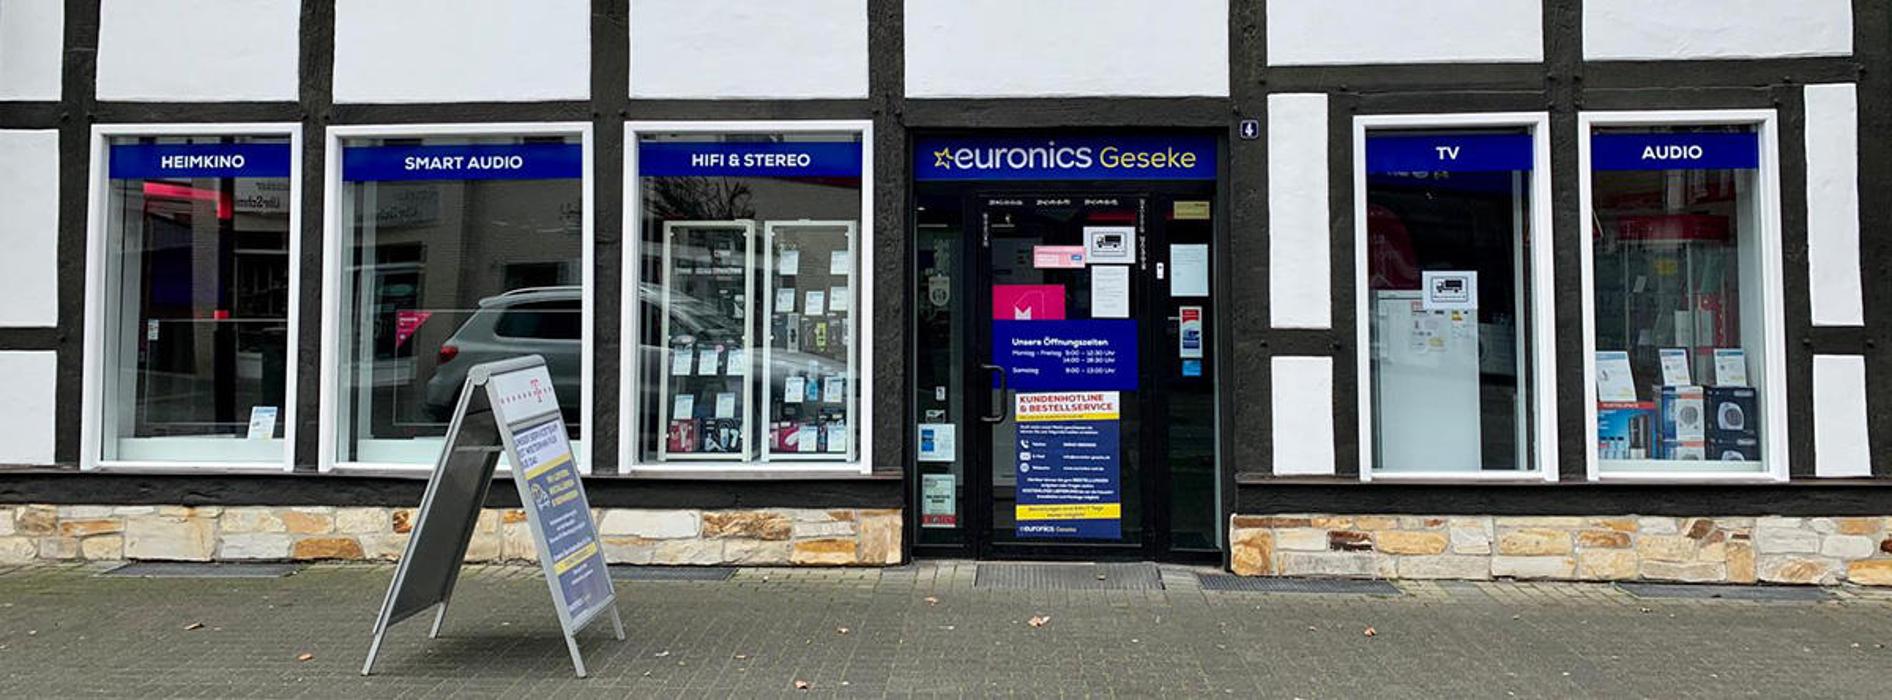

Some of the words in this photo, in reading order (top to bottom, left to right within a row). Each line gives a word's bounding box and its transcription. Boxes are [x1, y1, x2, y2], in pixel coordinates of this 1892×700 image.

[1244, 122, 1254, 137] 4
[954, 141, 1093, 169] euronics
[1100, 146, 1196, 169] Geseke
[1436, 146, 1460, 160] TV
[1642, 145, 1703, 160] AUDIO
[161, 154, 245, 169] HEIMKINO
[404, 156, 463, 171] SMART
[467, 155, 523, 169] AUDIO
[691, 154, 724, 167] HIFI
[728, 154, 740, 167] &
[744, 153, 811, 167] STEREO
[1011, 337, 1042, 346] Unsere
[1043, 336, 1109, 349] Öffnungszeiten
[1012, 367, 1040, 375] Samstag
[1019, 394, 1104, 404] KUNDENHOTLINE
[1019, 404, 1027, 413] &
[1028, 403, 1113, 412] BESTELLSERVICE
[1023, 525, 1055, 533] euronics
